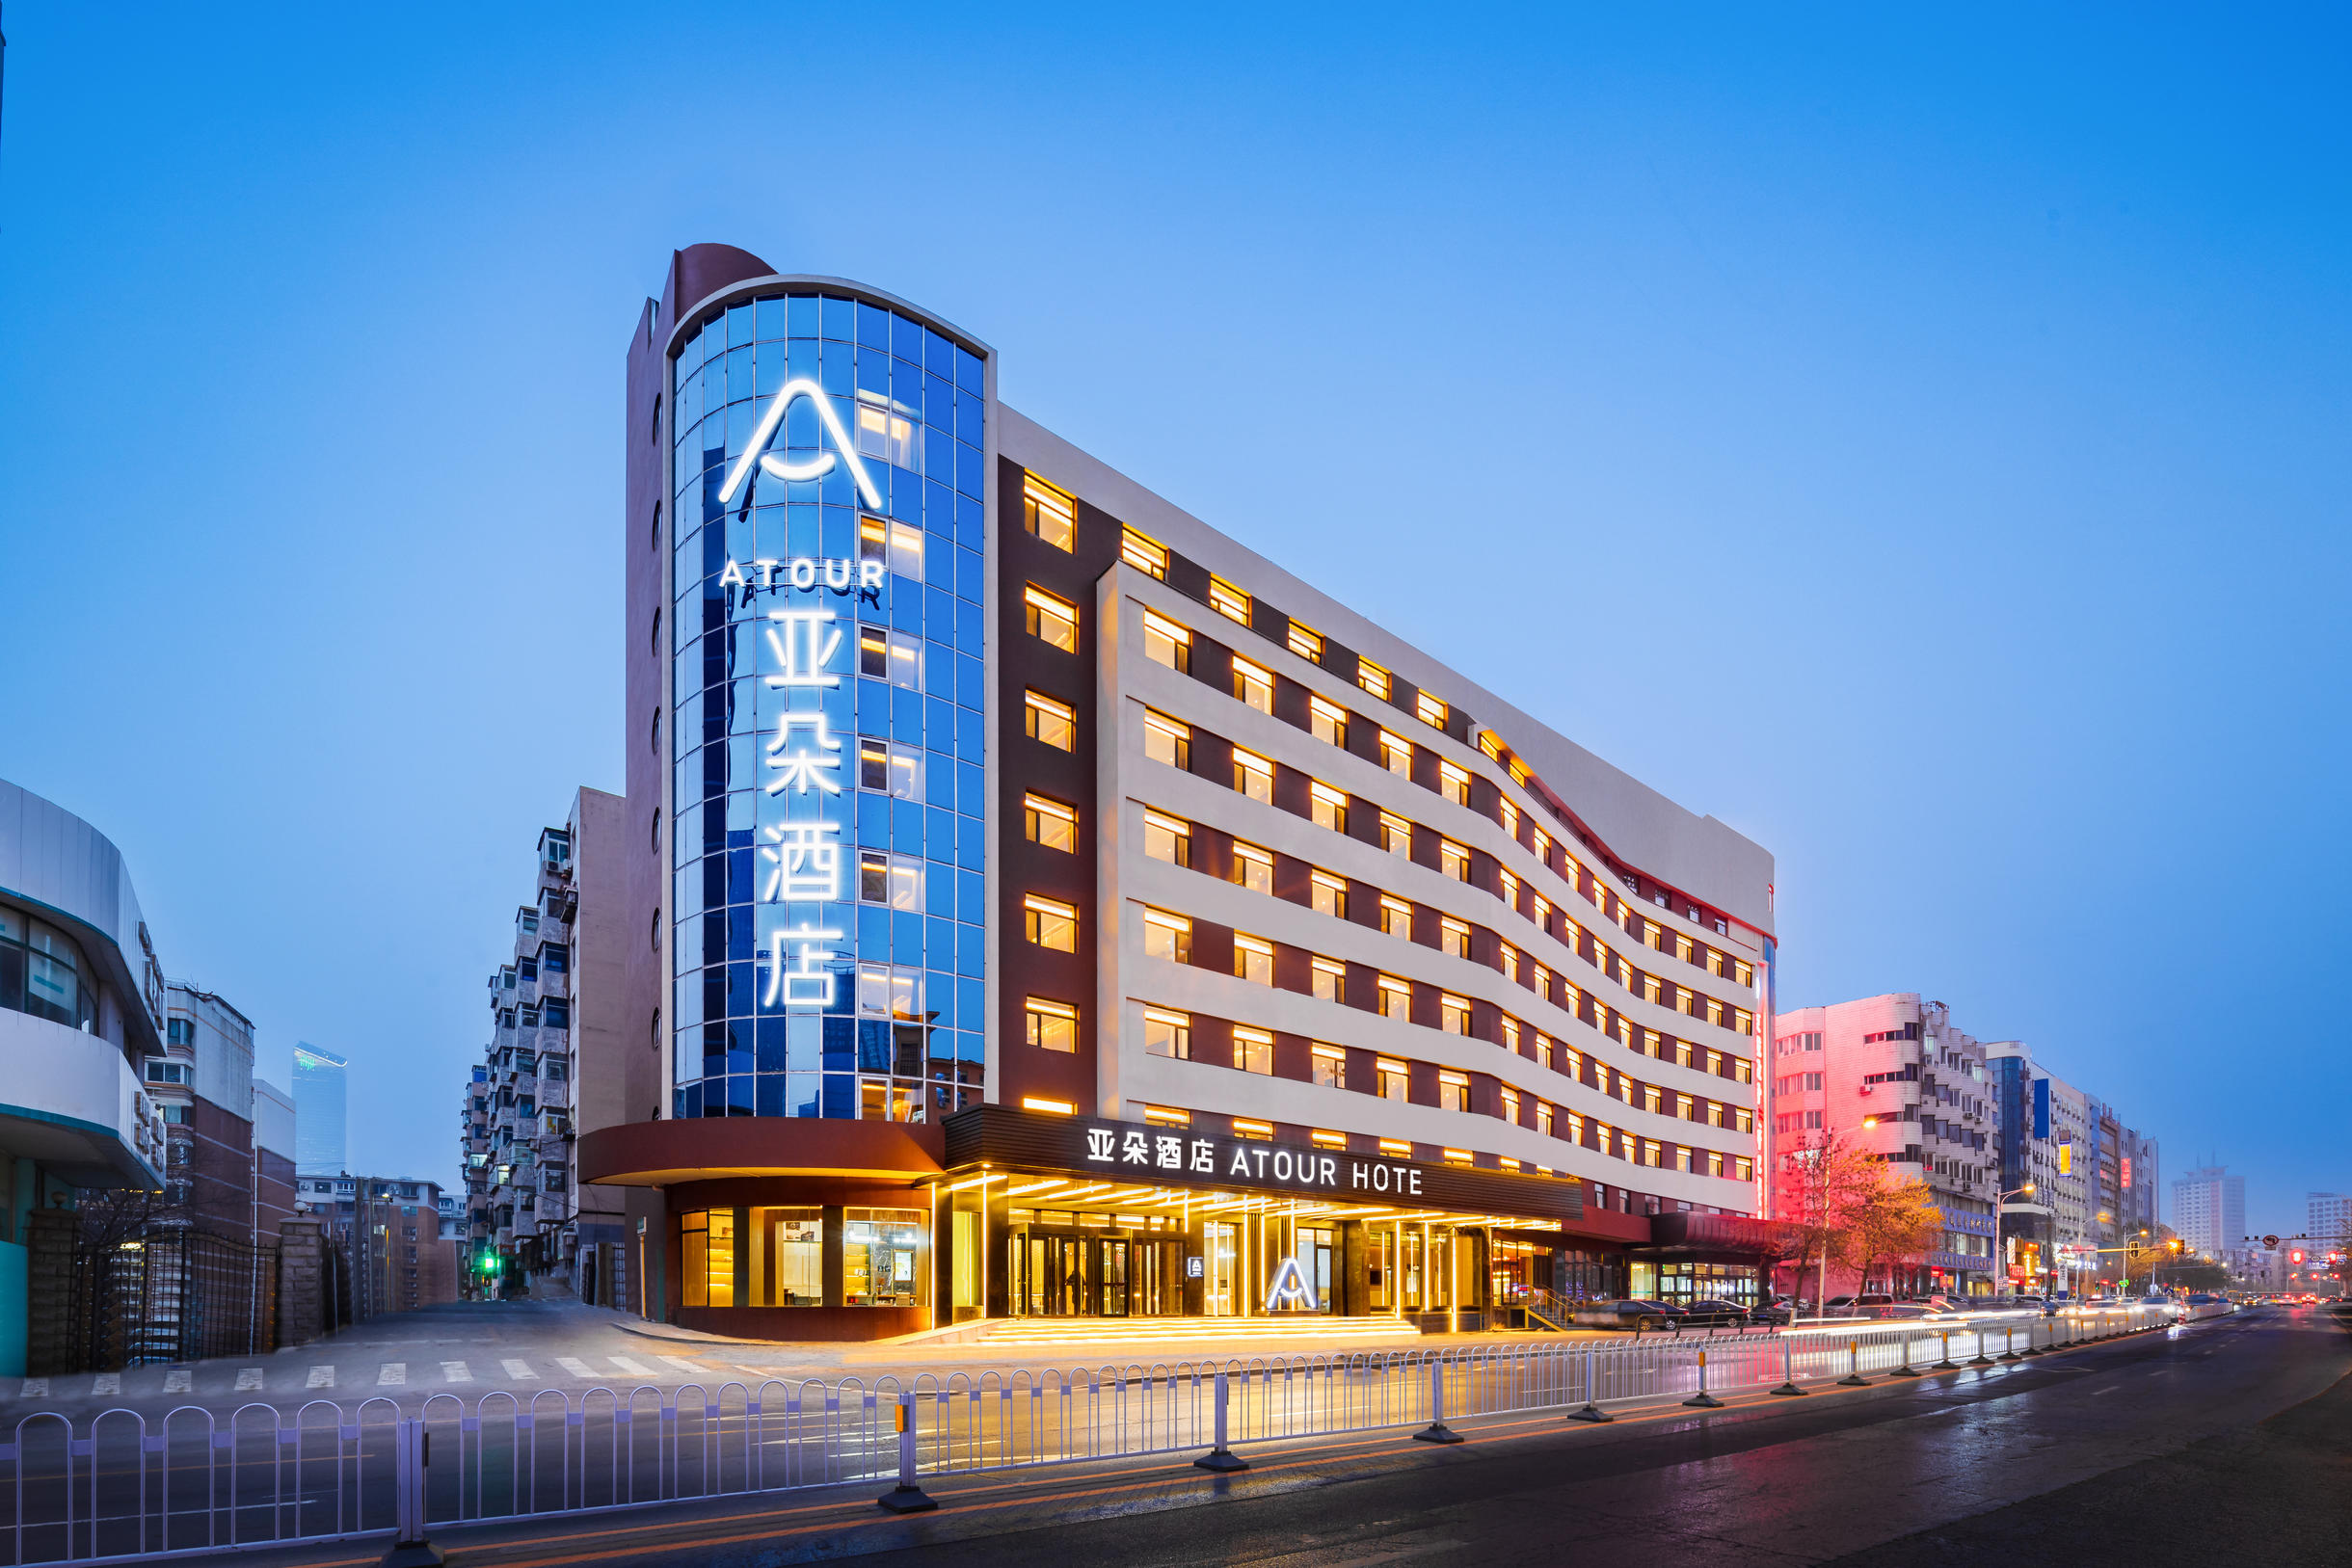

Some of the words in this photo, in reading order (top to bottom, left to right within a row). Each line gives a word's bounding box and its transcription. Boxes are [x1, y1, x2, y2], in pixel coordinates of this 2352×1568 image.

[717, 556, 885, 589] ATOUR
[763, 610, 843, 1008] 亚朵酒店
[1086, 1128, 1215, 1173] 亚朵酒店
[1230, 1148, 1336, 1185] ATOUR
[1352, 1162, 1423, 1195] HOTE
